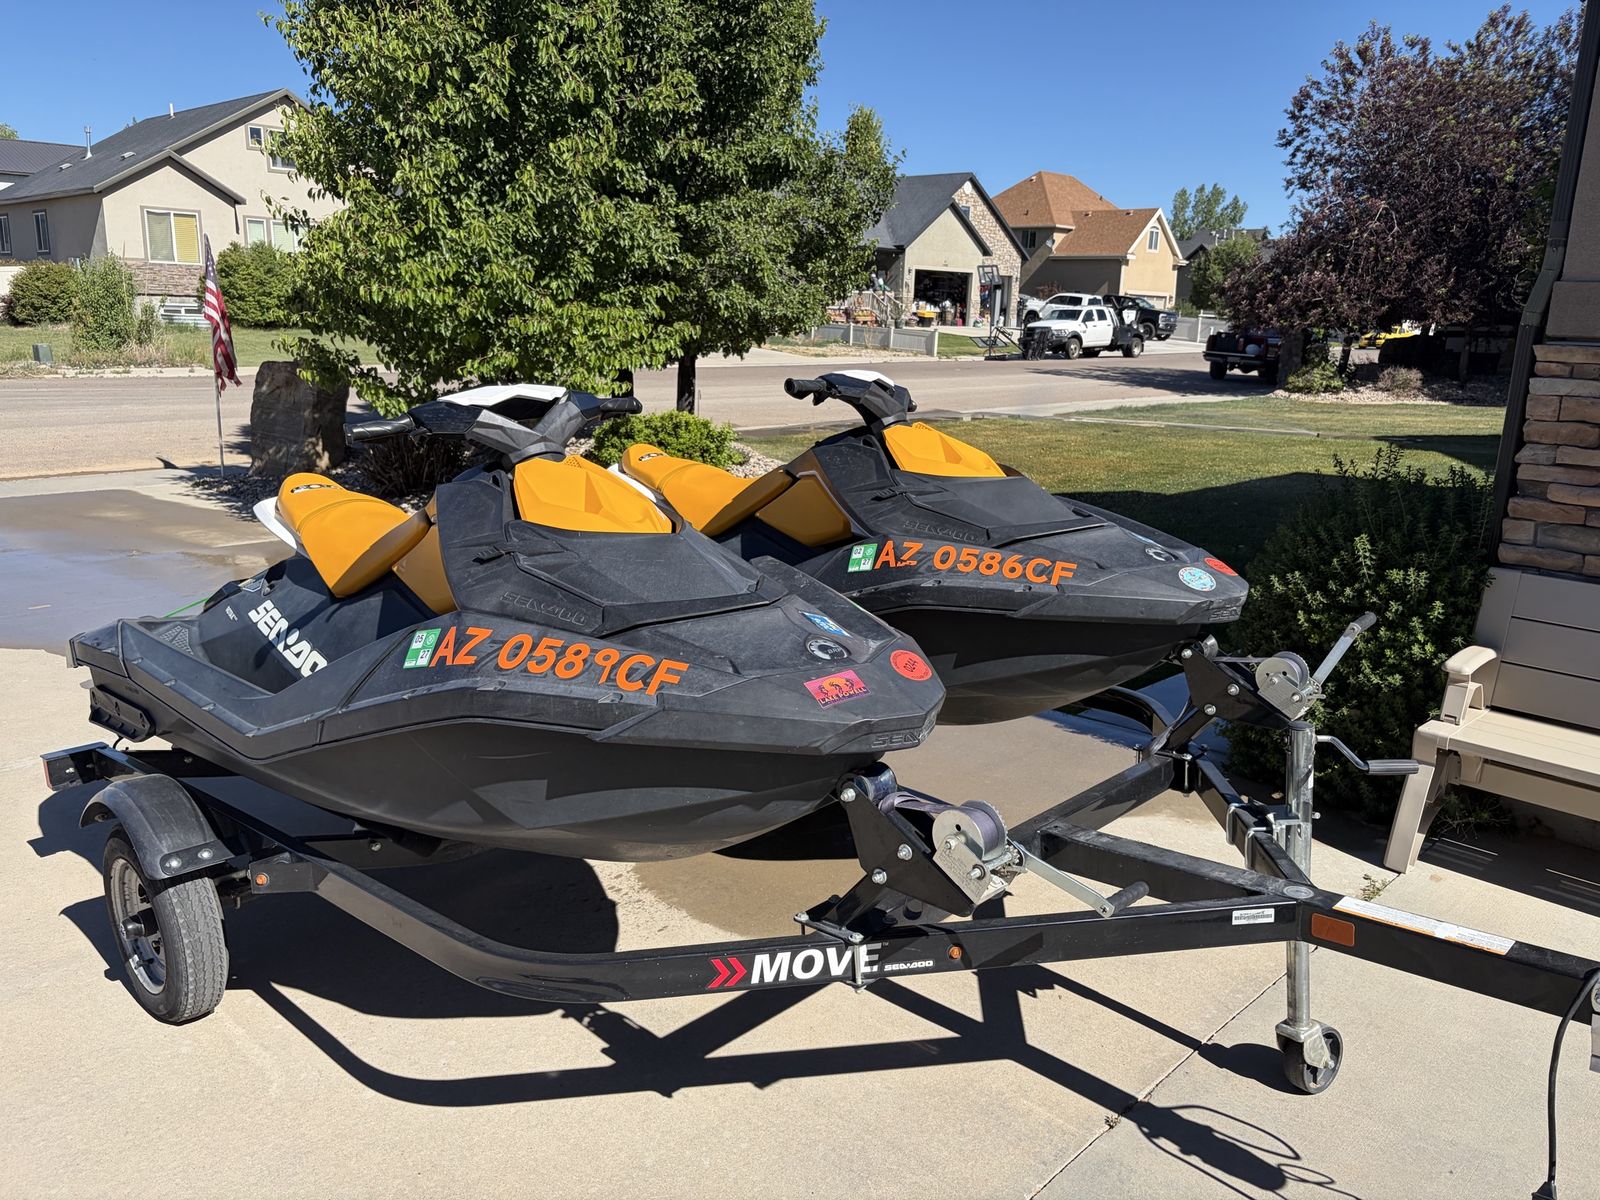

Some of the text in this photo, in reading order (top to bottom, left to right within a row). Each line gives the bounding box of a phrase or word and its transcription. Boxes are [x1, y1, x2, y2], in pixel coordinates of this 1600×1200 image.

[874, 540, 1078, 587] AZ 0586CF
[414, 634, 424, 644] 05
[420, 649, 430, 659] 27
[429, 626, 690, 696] AZ 0589CF
[839, 686, 867, 698] POWELL
[750, 943, 882, 984] MOVE
